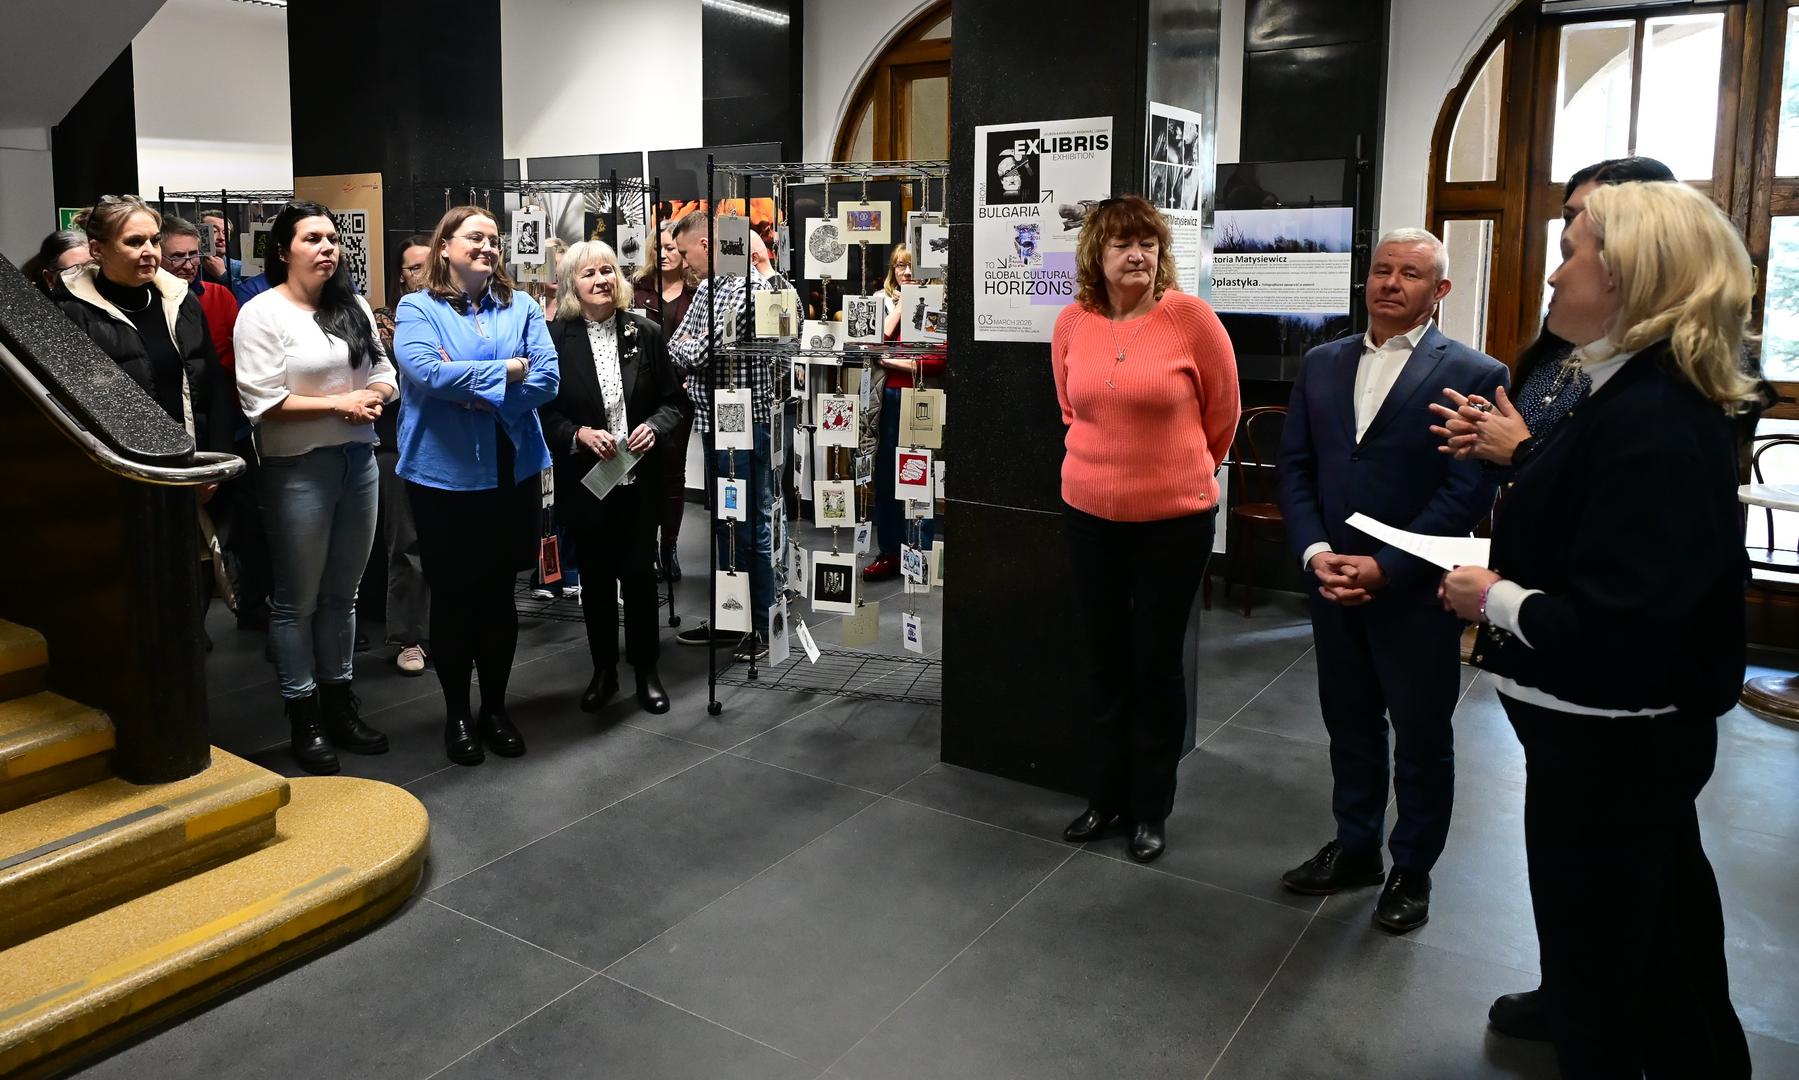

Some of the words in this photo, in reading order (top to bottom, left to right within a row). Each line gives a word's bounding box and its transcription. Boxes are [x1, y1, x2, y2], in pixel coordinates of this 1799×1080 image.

[1014, 134, 1109, 155] EXLIBRIS
[1052, 152, 1095, 161] EXHIBITION
[979, 206, 1040, 218] BULGARIA
[1235, 255, 1287, 264] Matysiewicz
[985, 261, 995, 269] TO
[985, 271, 1021, 279] GLOBAL
[1023, 271, 1073, 279] CULTURAL
[985, 281, 1073, 295] HORIZONS
[978, 314, 993, 325] 03
